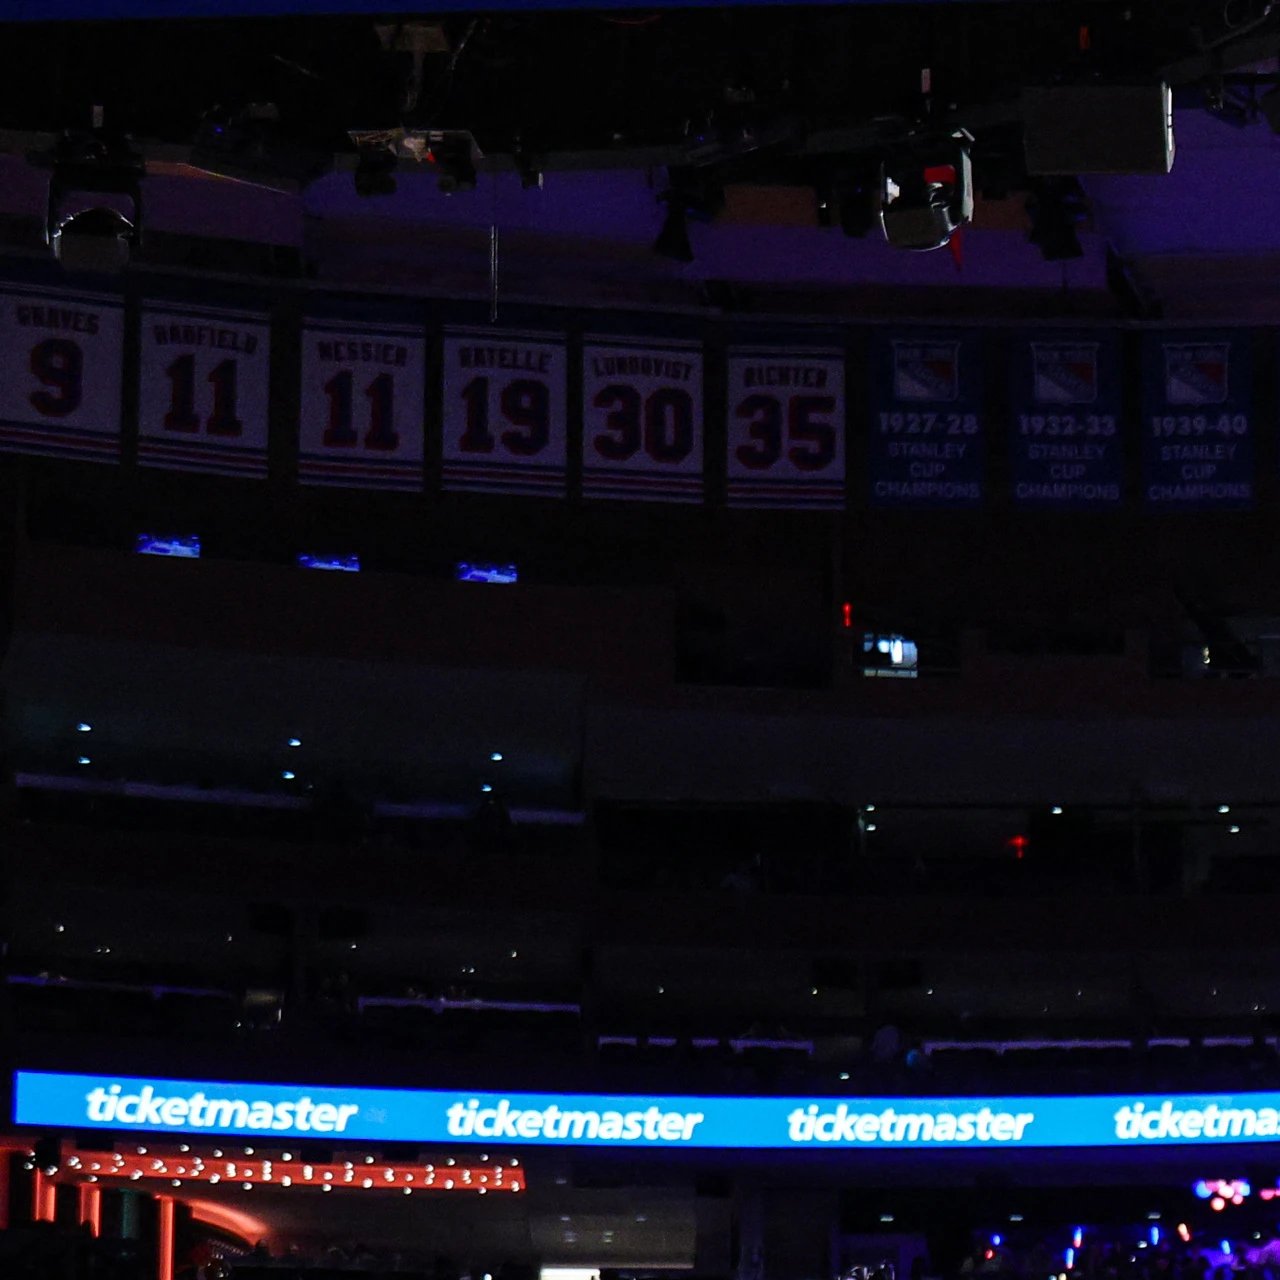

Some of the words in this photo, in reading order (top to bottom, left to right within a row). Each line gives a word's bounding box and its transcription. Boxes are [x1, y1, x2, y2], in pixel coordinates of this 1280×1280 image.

[458, 347, 552, 373] RATELLE
[30, 338, 83, 416] 9
[165, 354, 243, 436] 11
[323, 370, 400, 450] 11
[460, 377, 550, 455] 19
[594, 385, 693, 463] 30
[735, 395, 835, 471] 35
[879, 412, 978, 434] 1927-28
[1019, 414, 1117, 435] 1932-33
[1152, 415, 1247, 437] 1939-40
[888, 442, 967, 459] STANLEY
[1028, 444, 1106, 460] STANLEY
[1161, 444, 1237, 460] STANLEY
[910, 462, 945, 478] CUP
[1050, 463, 1086, 479] CUP
[1181, 462, 1216, 479] CUP
[875, 481, 980, 499] CHAMPIONS
[1015, 483, 1119, 500] CHAMPIONS
[1148, 484, 1251, 500] CHAMPIONS
[87, 1085, 358, 1132] ticketmaster
[447, 1100, 703, 1141] ticketmaster
[788, 1104, 1034, 1142] ticketmaster
